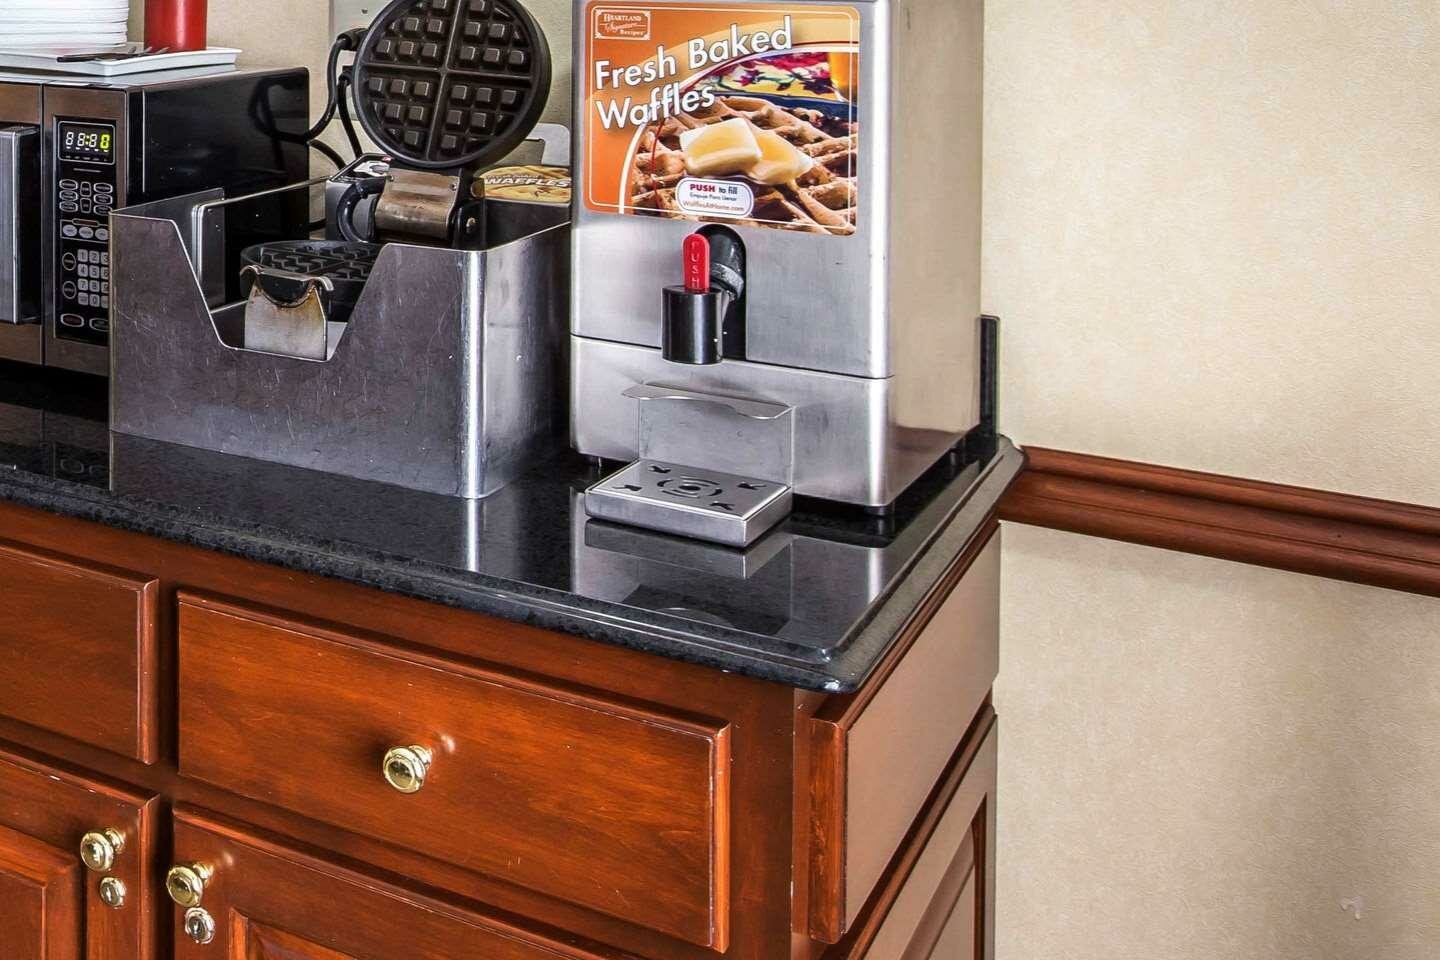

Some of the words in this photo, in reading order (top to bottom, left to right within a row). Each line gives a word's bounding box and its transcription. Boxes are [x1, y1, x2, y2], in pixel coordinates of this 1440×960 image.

[594, 44, 677, 90] Fresh
[688, 14, 793, 70] Baked
[595, 80, 716, 130] Waffles
[484, 178, 572, 187] WAFFLES
[690, 184, 715, 192] PUSH
